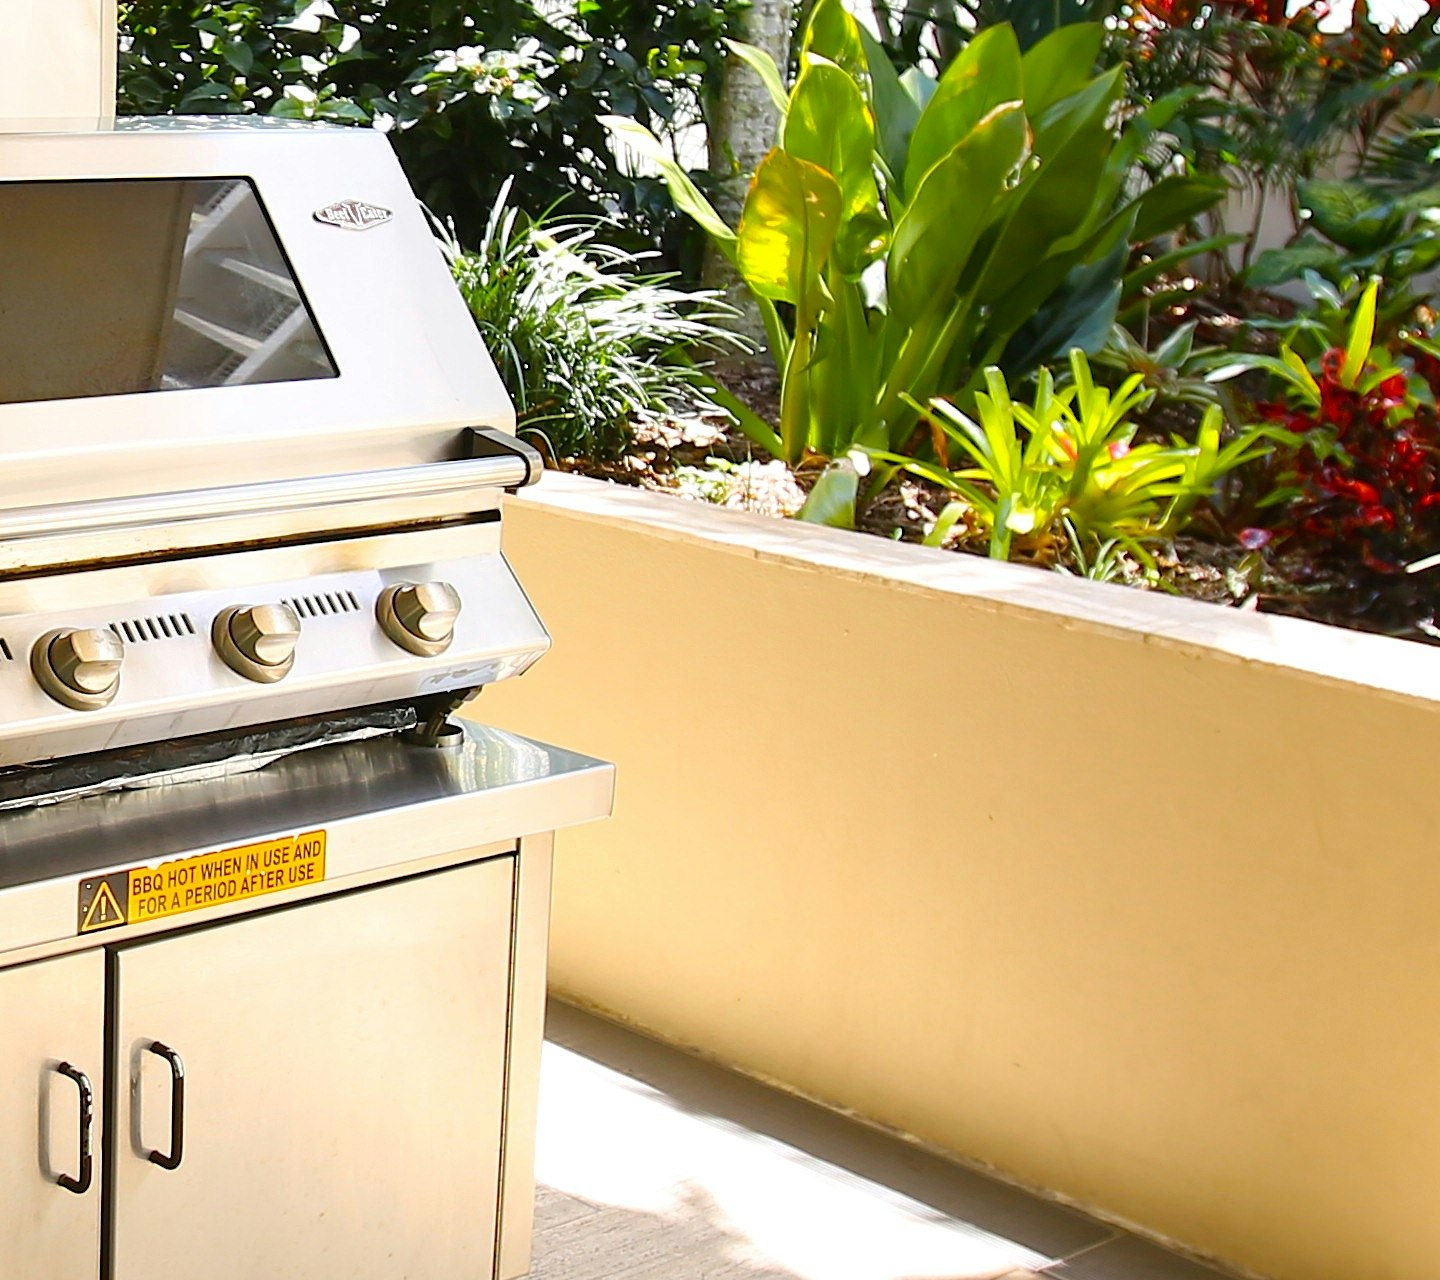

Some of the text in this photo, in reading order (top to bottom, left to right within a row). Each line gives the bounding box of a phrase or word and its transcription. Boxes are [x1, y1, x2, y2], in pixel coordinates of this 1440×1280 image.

[133, 840, 321, 896] BBQ HOT WHEN IN USE AND
[138, 863, 314, 917] FOR A PERIOD AFTER USE
